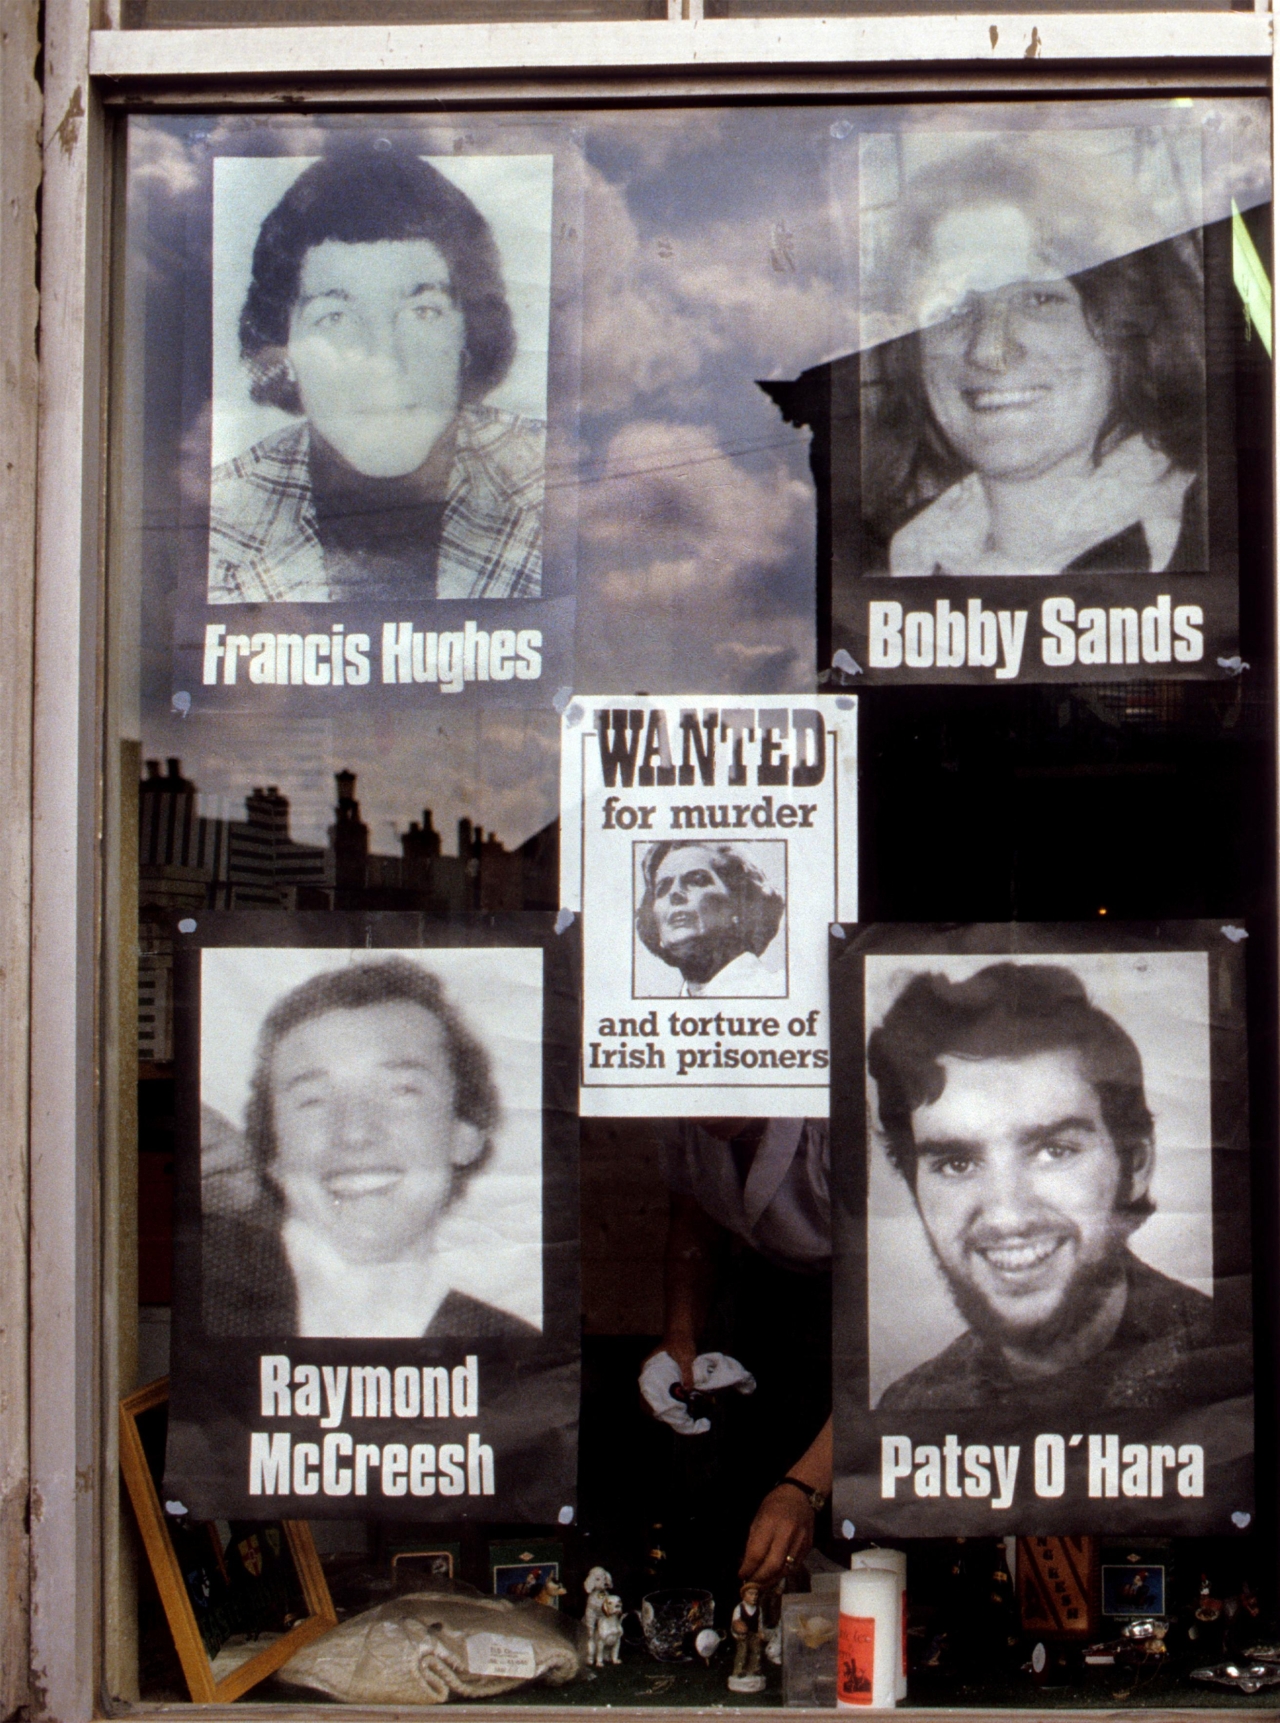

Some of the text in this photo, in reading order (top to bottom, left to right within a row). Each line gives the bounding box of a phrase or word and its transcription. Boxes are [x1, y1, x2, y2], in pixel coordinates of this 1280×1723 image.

[203, 620, 542, 693] Francis Hughes
[868, 595, 1204, 680] Bobby Sands
[594, 708, 826, 787] WANTED
[602, 797, 817, 829] for murder
[588, 1043, 829, 1075] Irish prisoners
[598, 1010, 820, 1036] and torture of
[260, 1354, 479, 1429] Raymond
[249, 1432, 495, 1496] McCreesh
[881, 1434, 1020, 1509] Patsy
